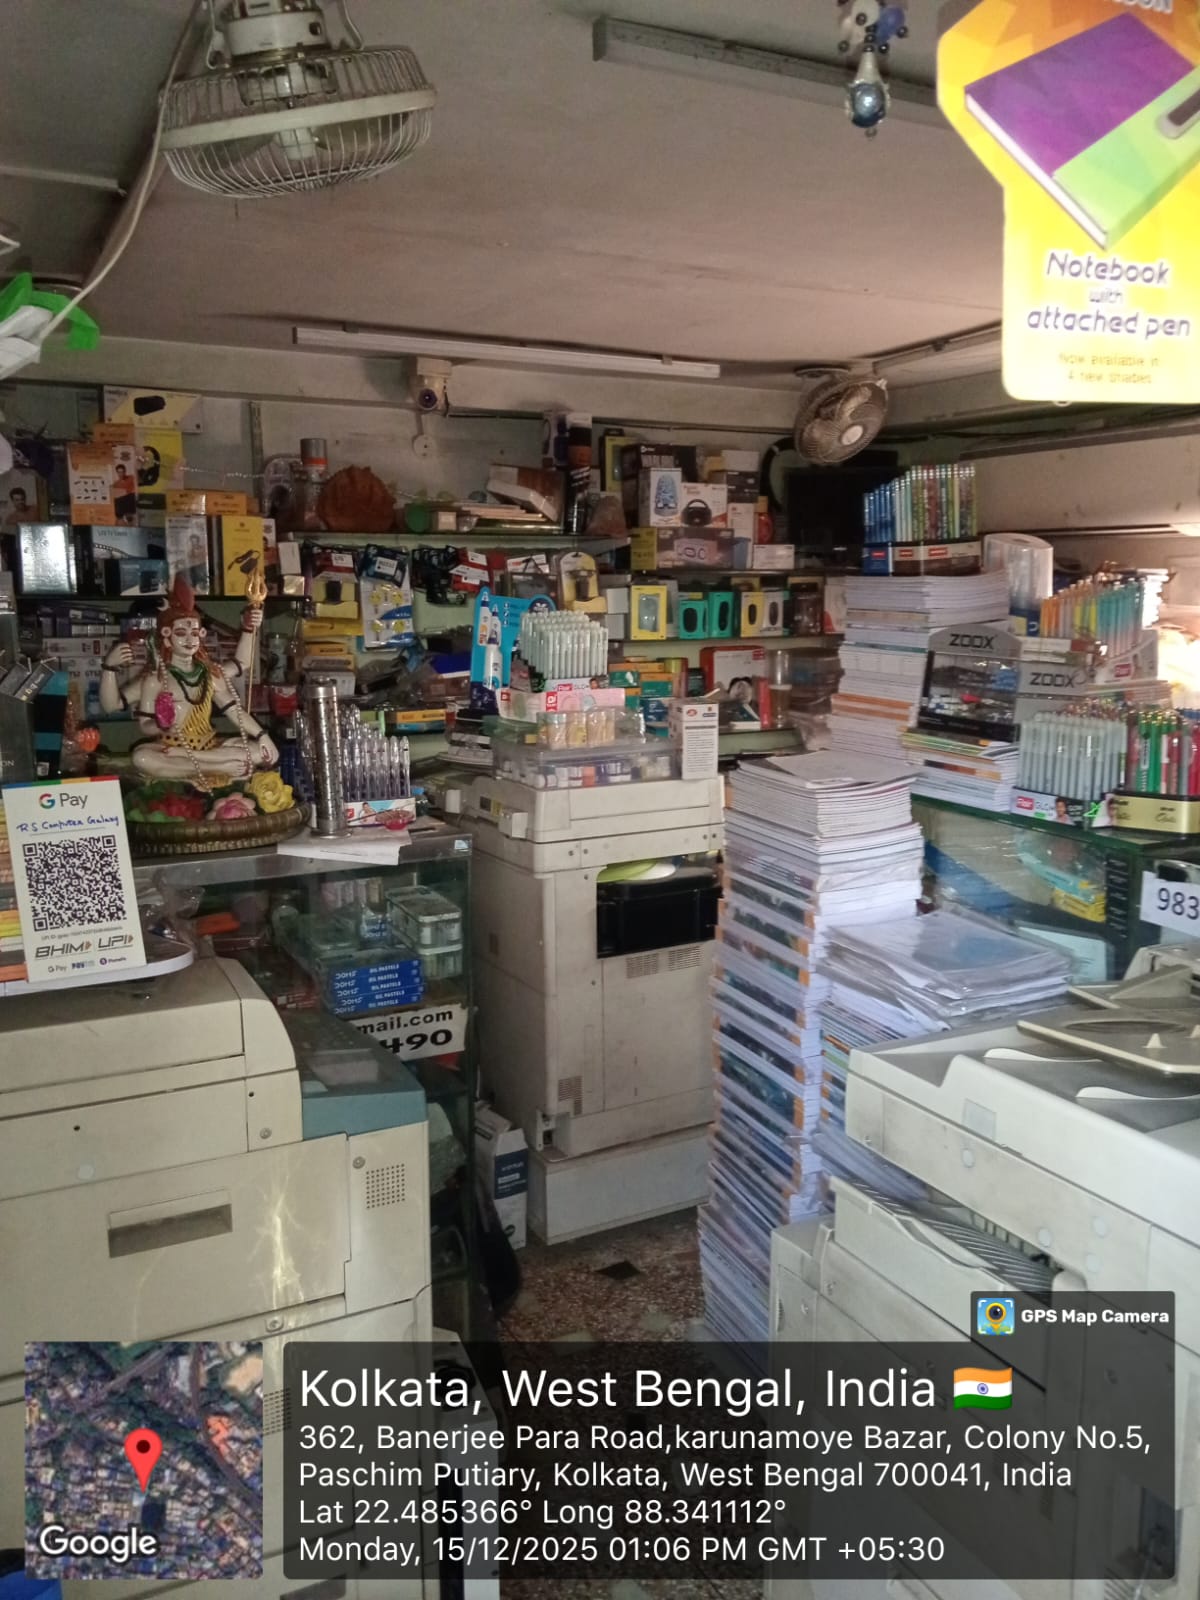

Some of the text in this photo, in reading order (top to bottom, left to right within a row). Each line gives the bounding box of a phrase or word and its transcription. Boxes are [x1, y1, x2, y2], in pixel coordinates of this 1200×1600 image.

[1047, 252, 1169, 284] Notebook
[1089, 289, 1123, 304] with
[1028, 306, 1191, 340] attached pen
[949, 634, 995, 649] ZOOX
[1030, 672, 1075, 688] ZOOX
[60, 793, 88, 809] Pay
[32, 823, 39, 832] S
[1157, 888, 1200, 920] 983
[35, 934, 127, 958] BHIM UPI
